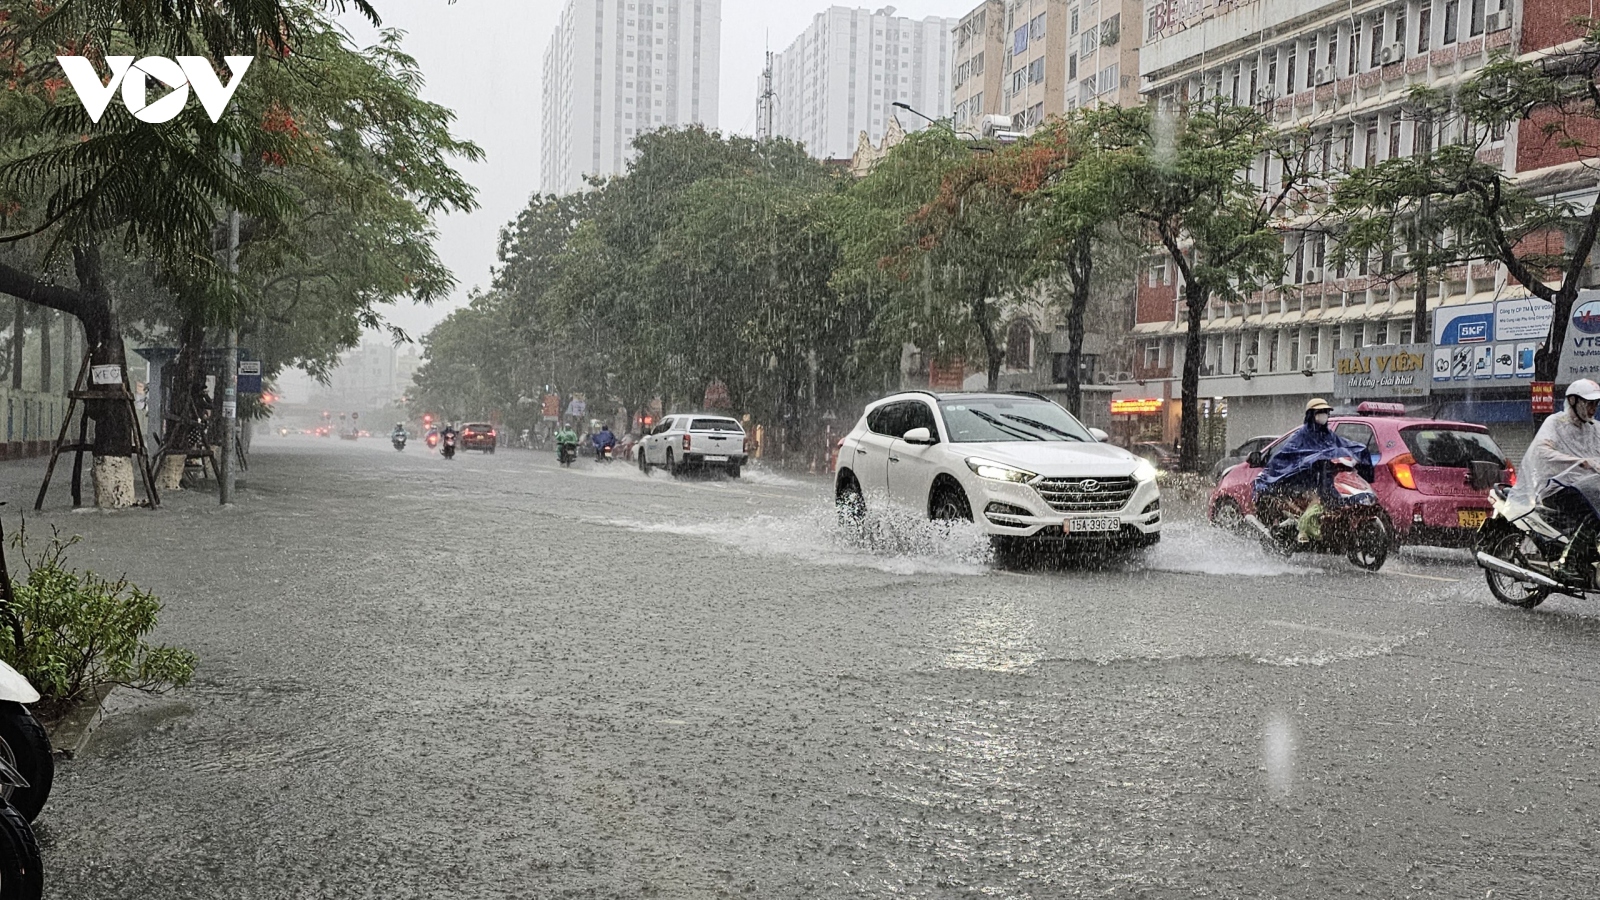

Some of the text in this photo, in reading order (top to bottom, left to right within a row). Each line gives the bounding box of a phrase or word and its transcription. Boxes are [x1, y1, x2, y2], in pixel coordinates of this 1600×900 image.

[1461, 325, 1485, 336] SKF
[1337, 349, 1426, 375] HẢI VIÊN
